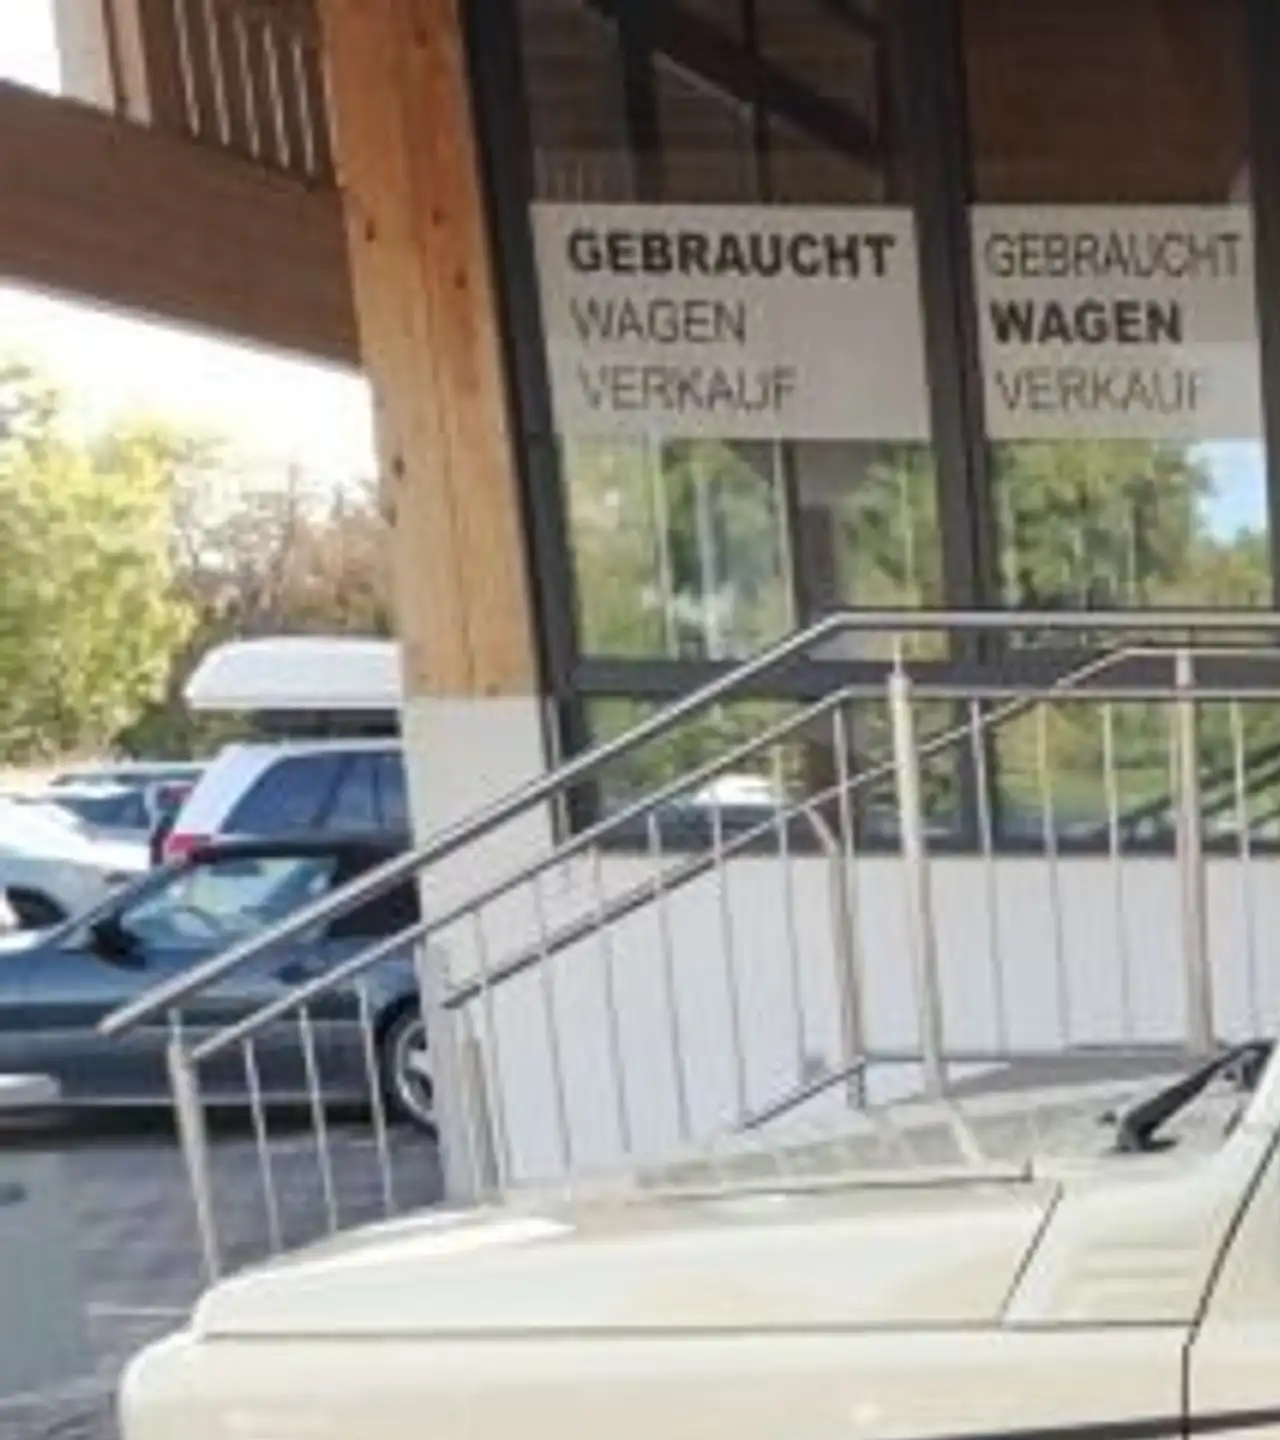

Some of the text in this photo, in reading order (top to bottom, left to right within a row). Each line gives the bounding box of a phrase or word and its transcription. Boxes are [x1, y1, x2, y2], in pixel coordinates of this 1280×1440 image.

[567, 230, 895, 278] GEBRAUCHT
[985, 230, 1241, 279] GEBRAUCHT
[570, 297, 747, 346] WAGEN
[990, 299, 1182, 345] WAGEN
[579, 363, 797, 415] VERKAUF
[995, 365, 1206, 414] VERKAUF
